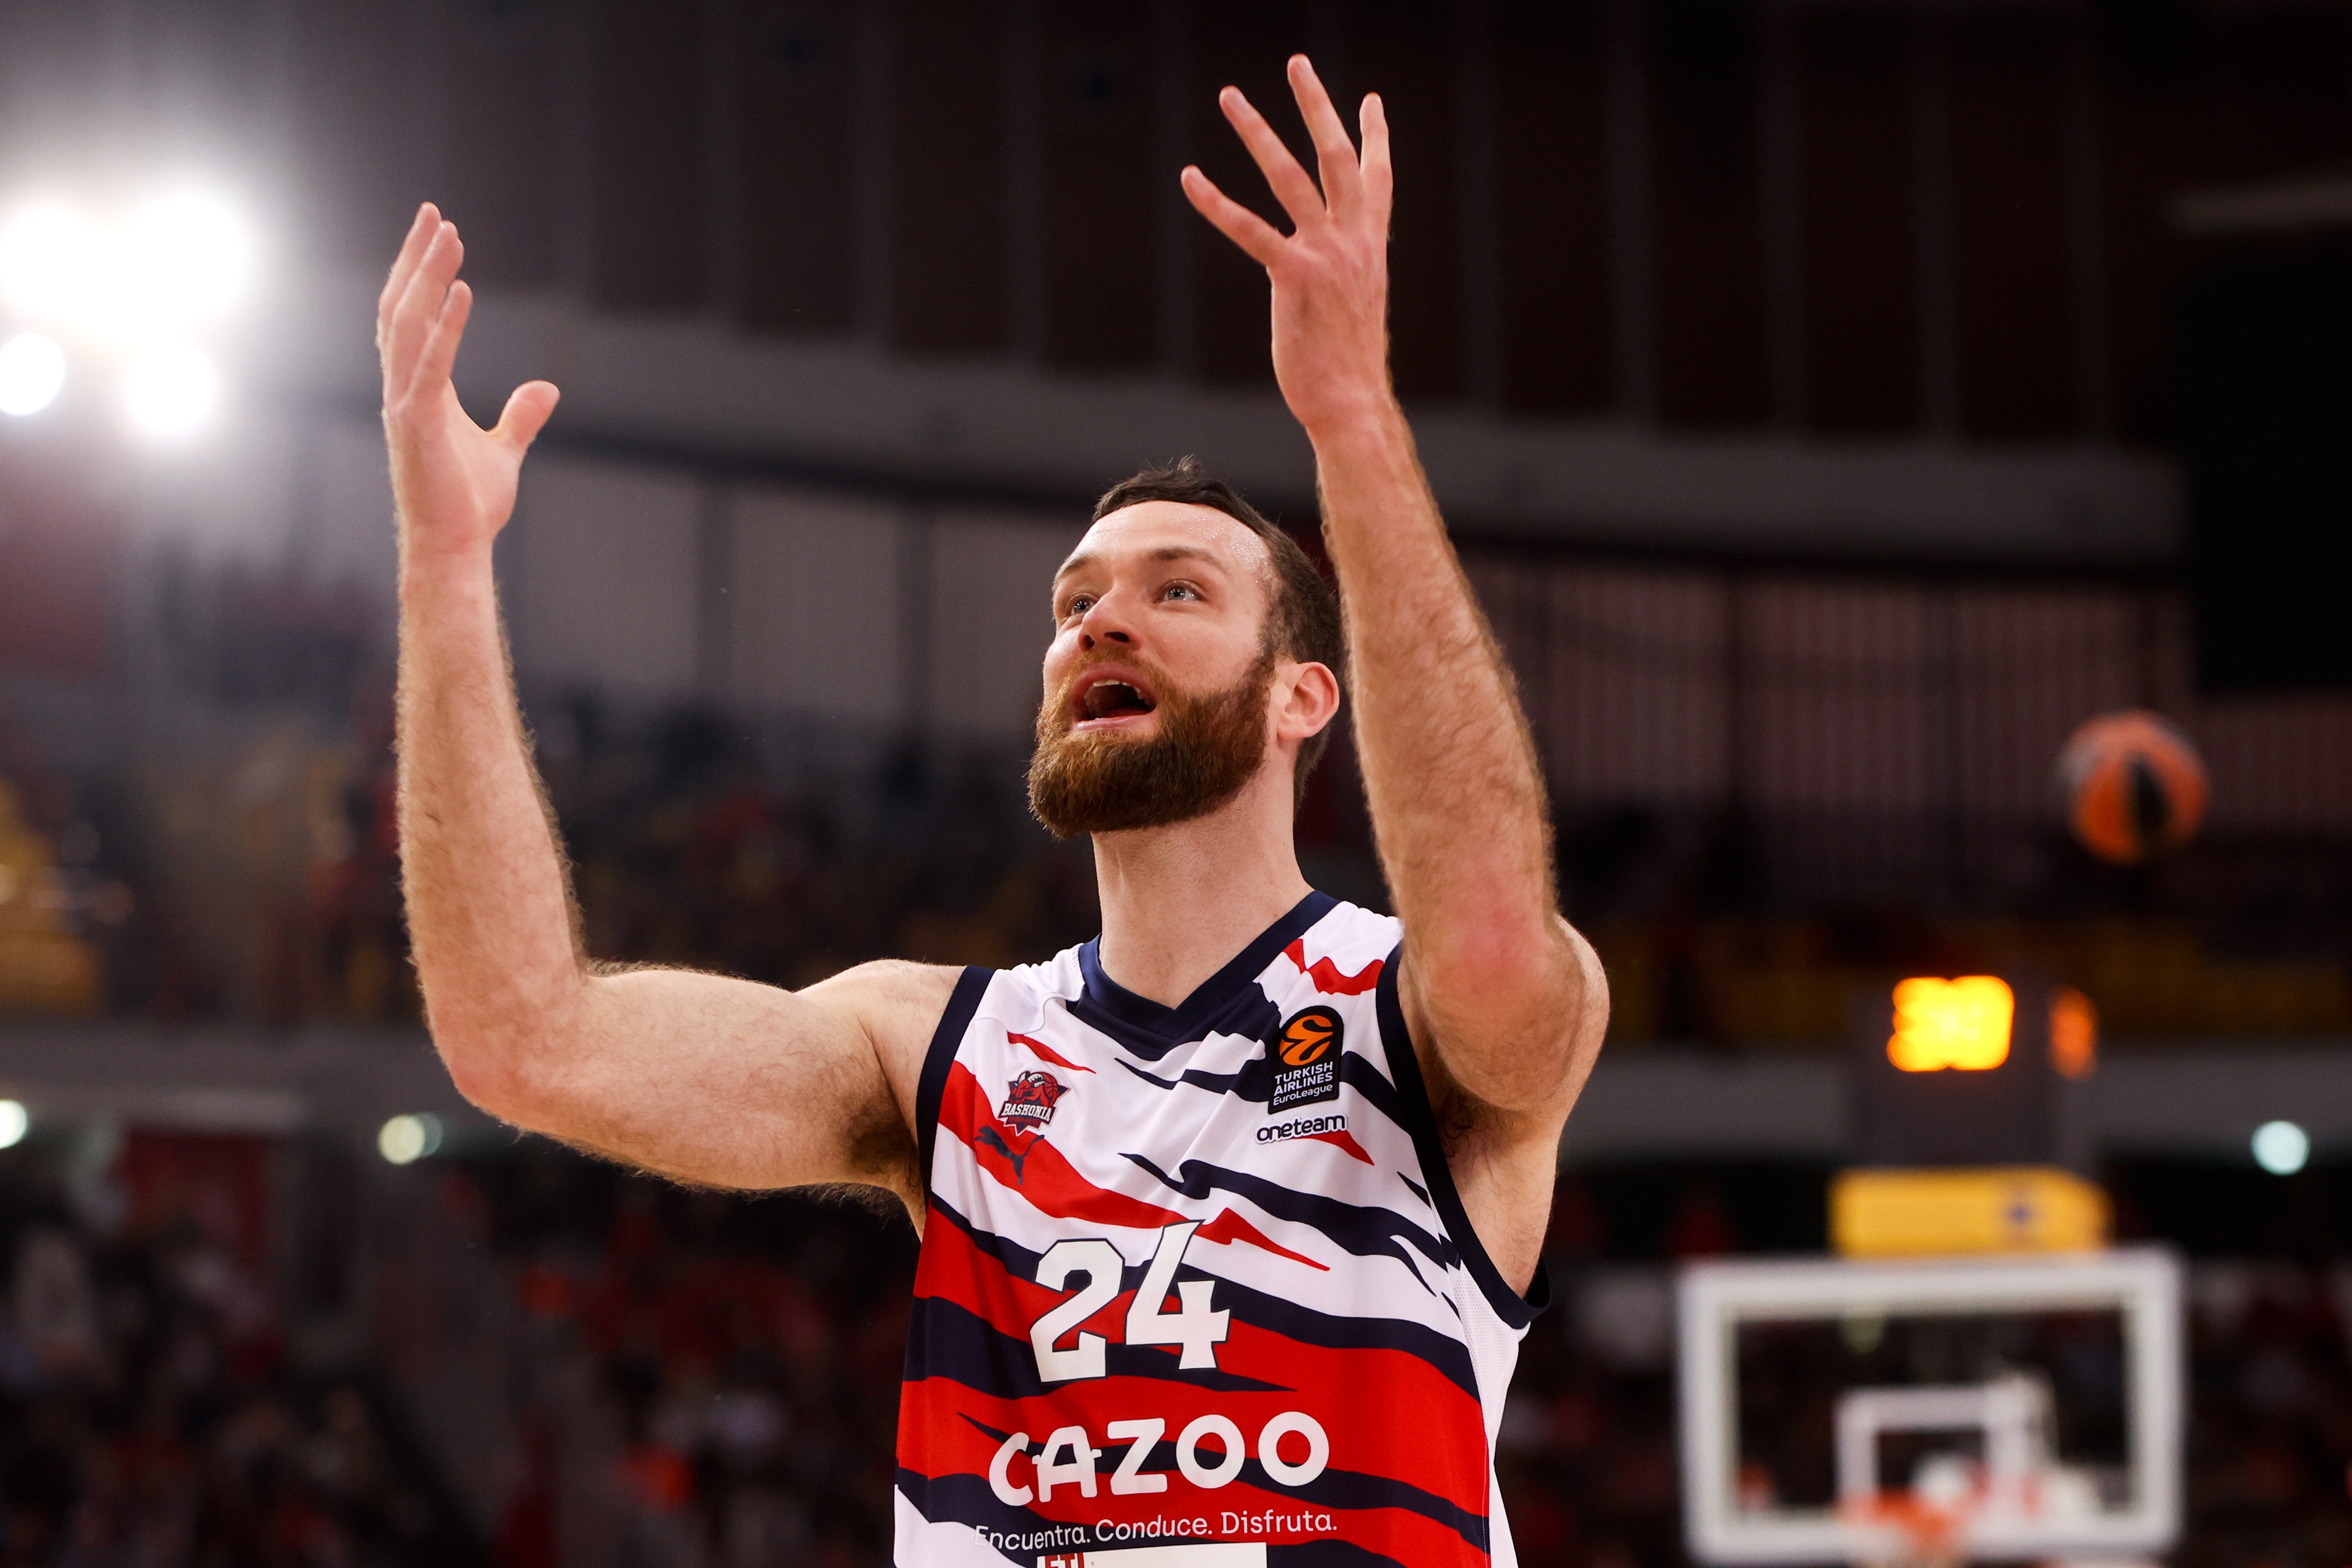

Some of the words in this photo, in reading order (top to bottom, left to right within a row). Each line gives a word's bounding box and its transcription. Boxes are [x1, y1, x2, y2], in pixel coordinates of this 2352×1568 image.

[1273, 1071, 1333, 1096] AIRLINES
[1275, 1061, 1333, 1085] TURKISH
[1273, 1084, 1333, 1106] EuroLeague
[1256, 1115, 1346, 1141] oneteam
[1030, 1220, 1231, 1382] 24
[988, 1411, 1330, 1507] CAZOO
[974, 1525, 1091, 1550] Encuentra.
[1095, 1514, 1213, 1542] Conduce.
[1220, 1509, 1337, 1534] Disfruta.
